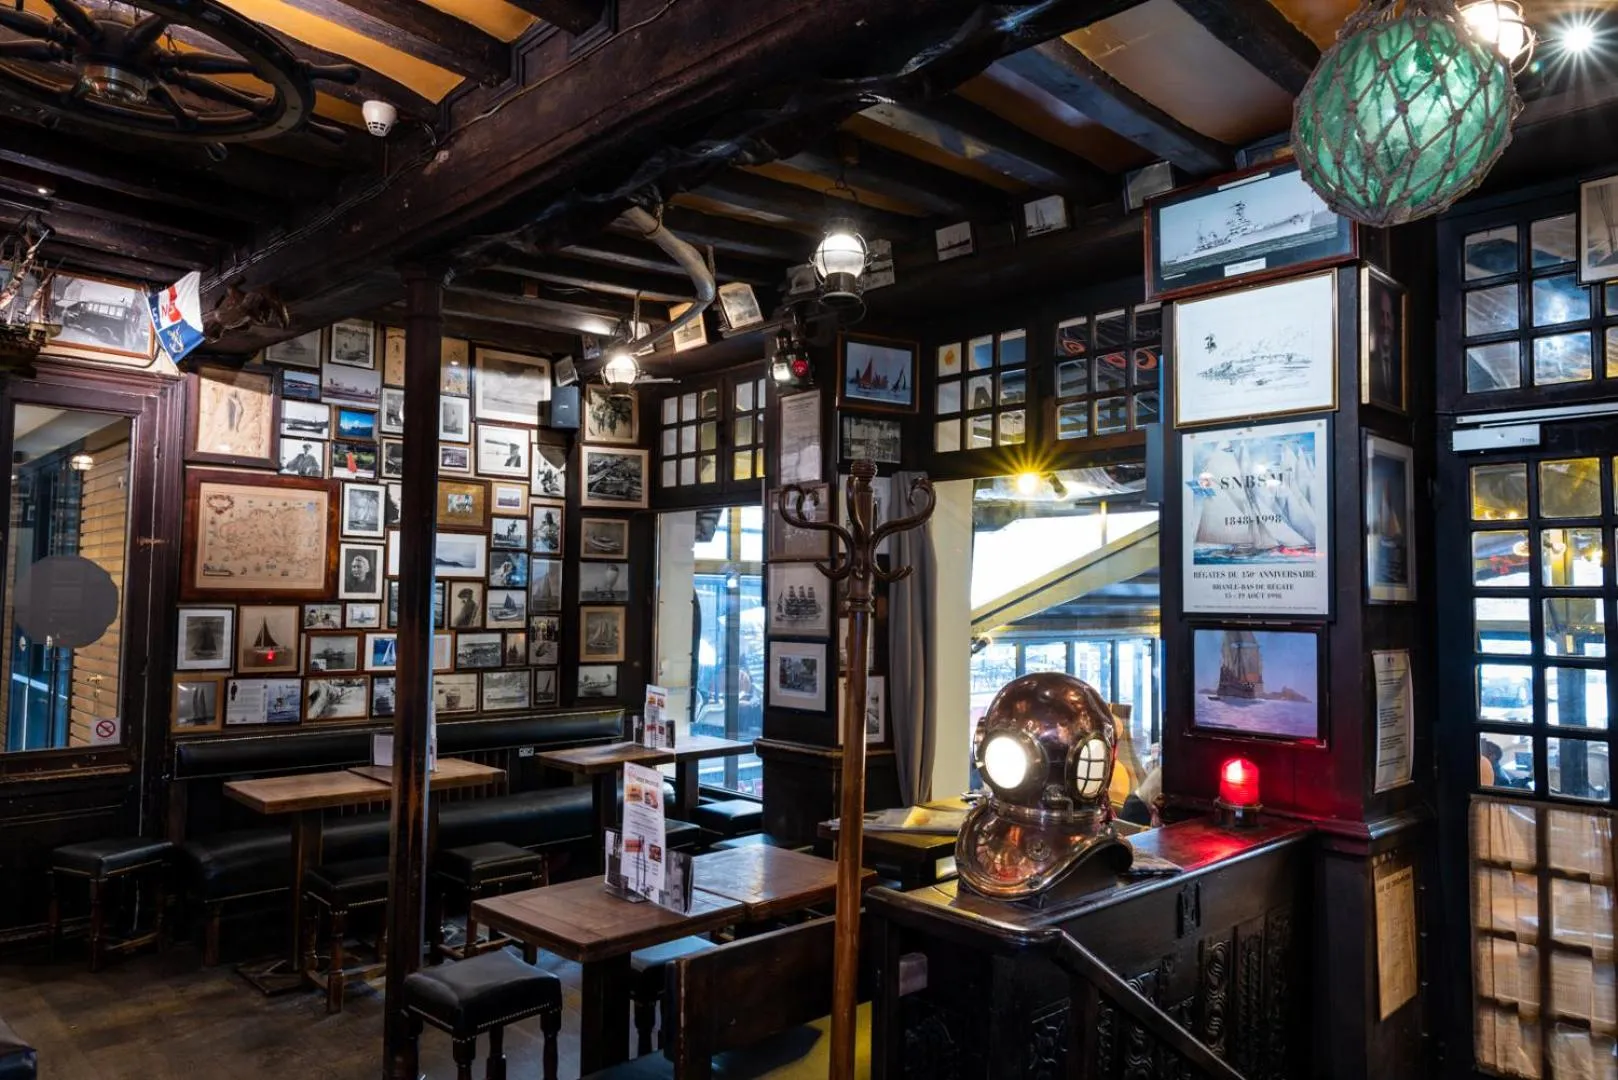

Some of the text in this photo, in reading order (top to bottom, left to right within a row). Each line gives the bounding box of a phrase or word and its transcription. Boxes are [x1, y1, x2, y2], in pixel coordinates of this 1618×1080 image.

[1220, 473, 1283, 489] SNBSM
[1193, 570, 1226, 578] RÉGATES
[1259, 570, 1317, 578] ANNIVERSAIRE
[1267, 582, 1295, 590] RÉGATE
